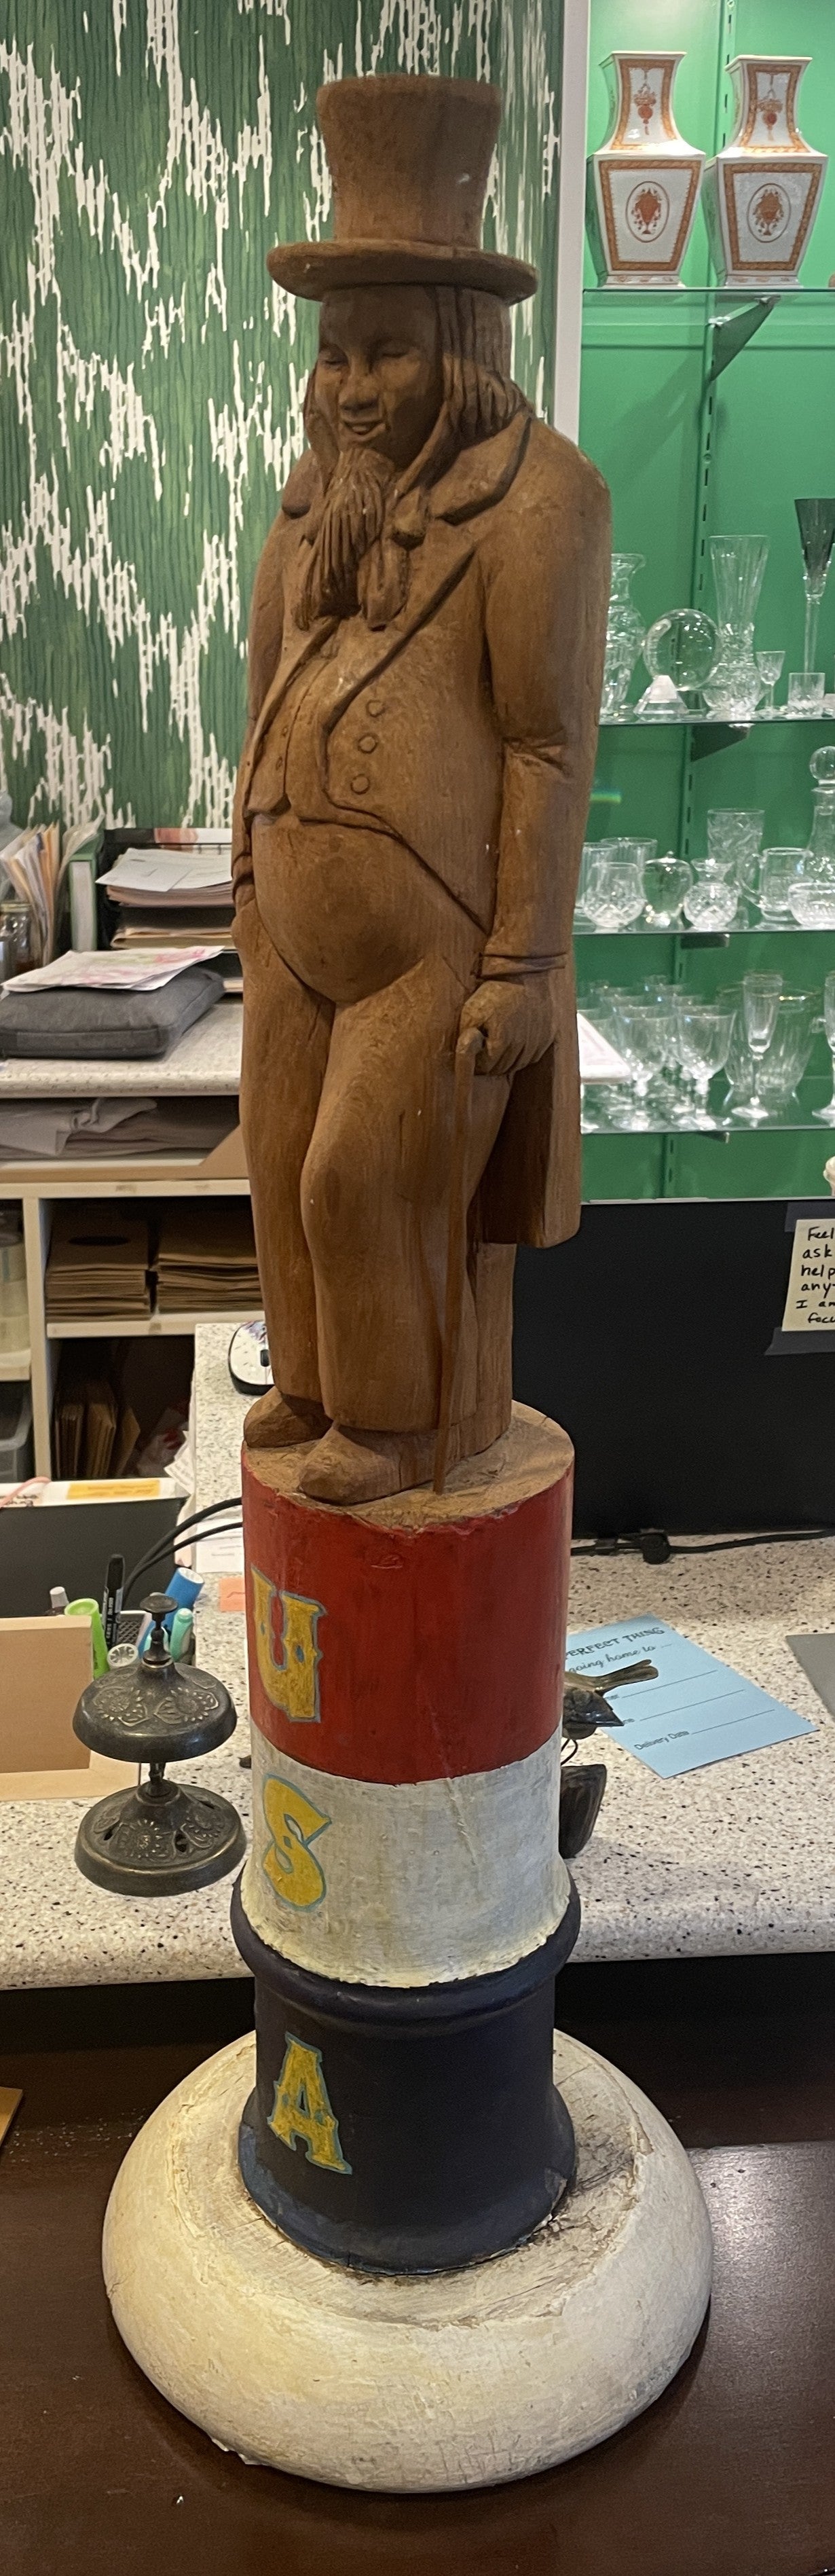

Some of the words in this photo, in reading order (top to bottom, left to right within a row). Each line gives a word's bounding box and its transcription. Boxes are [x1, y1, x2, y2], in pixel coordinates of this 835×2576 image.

[807, 1226, 834, 1241] Feel
[802, 1244, 832, 1258] ask
[800, 1265, 835, 1280] help
[796, 1299, 808, 1309] I
[622, 1627, 665, 1642] THING
[250, 1565, 327, 1724] U
[568, 1659, 605, 1674] going
[605, 1649, 642, 1663] home
[633, 1737, 670, 1750] Delivery
[262, 1773, 332, 1912] S
[267, 2031, 353, 2175] A
